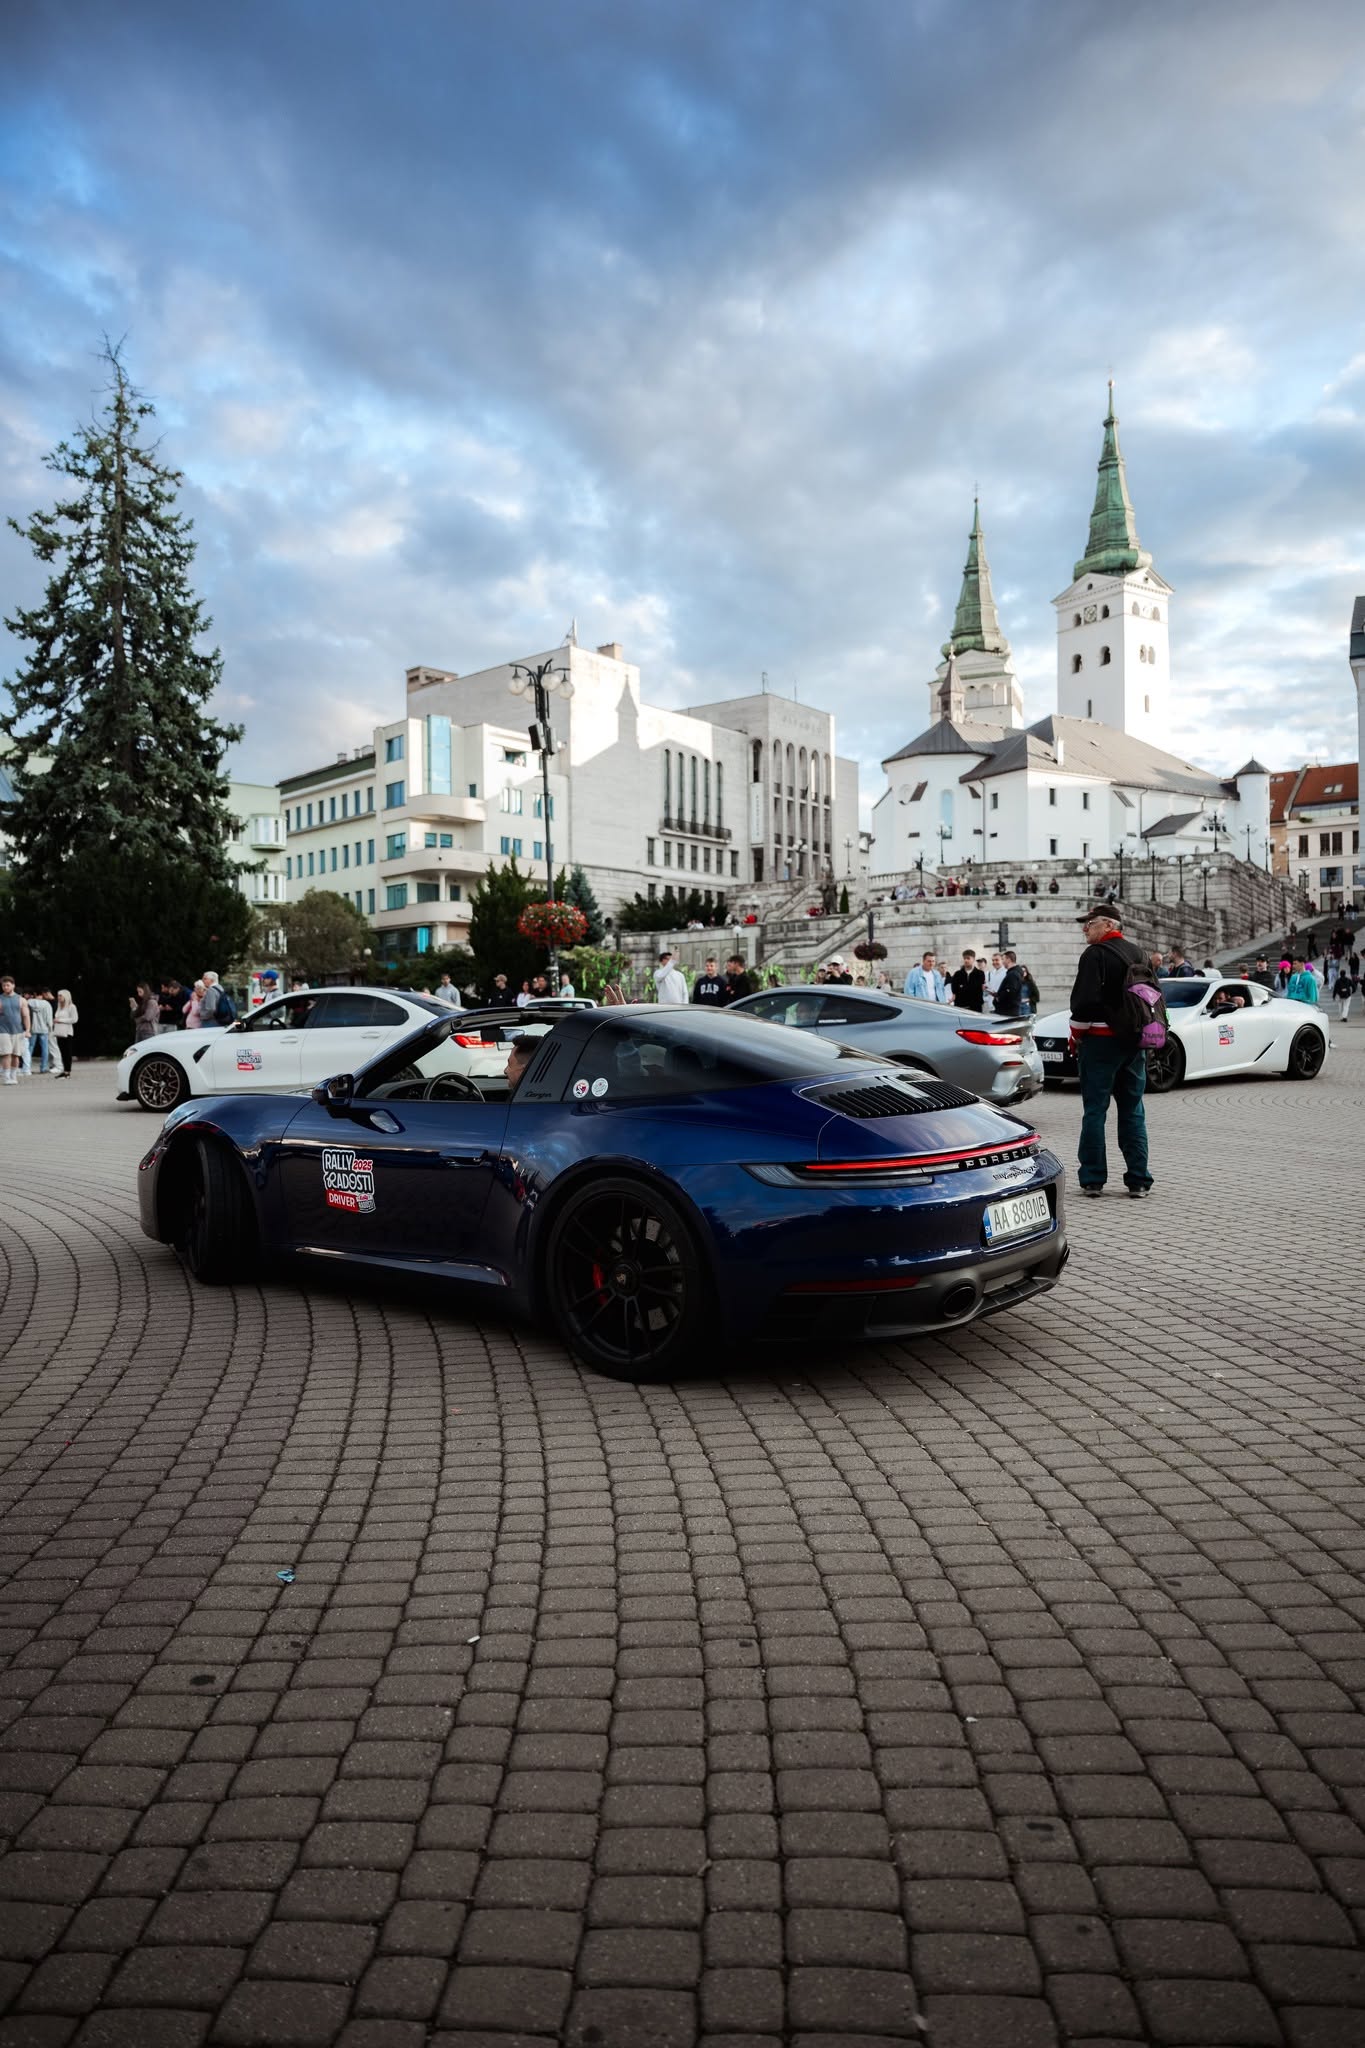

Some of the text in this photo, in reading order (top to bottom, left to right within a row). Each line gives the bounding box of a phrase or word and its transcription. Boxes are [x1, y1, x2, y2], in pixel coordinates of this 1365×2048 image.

[700, 983, 719, 995] GAP
[325, 1153, 373, 1171] RALLY 2025
[965, 1146, 1035, 1168] PORSCHE
[326, 1172, 372, 1191] RADOSTI
[329, 1193, 356, 1208] DRIVER
[994, 1196, 1047, 1231] AA 880NB
